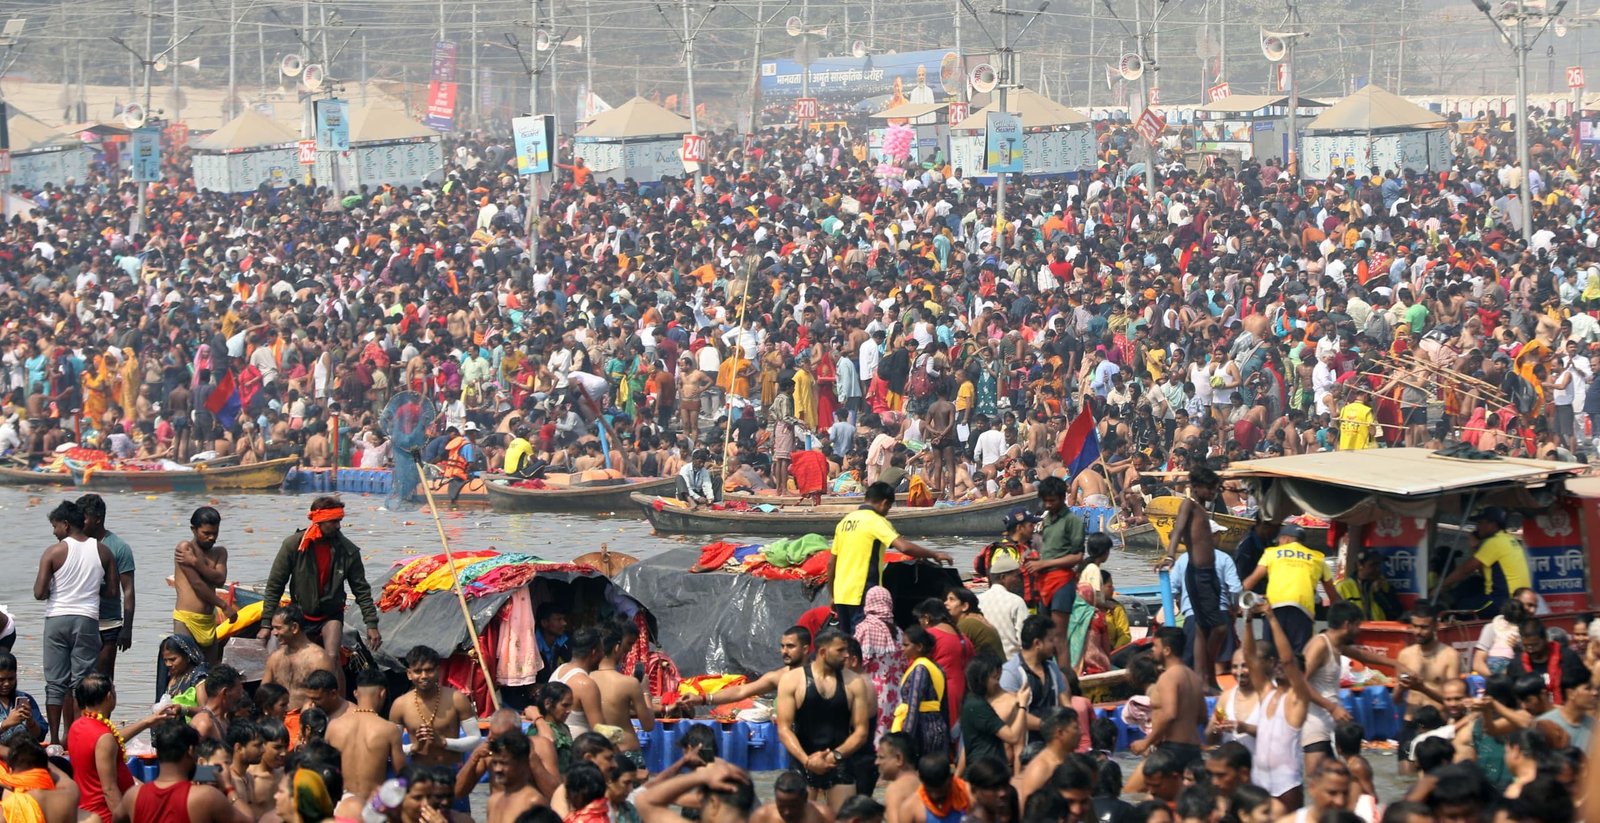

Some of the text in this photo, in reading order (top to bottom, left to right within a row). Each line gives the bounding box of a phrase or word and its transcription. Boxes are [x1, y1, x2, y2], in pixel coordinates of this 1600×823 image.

[776, 73, 802, 85] मानवता
[798, 101, 815, 117] 278
[1138, 112, 1161, 144] 237
[685, 138, 706, 160] 240
[1276, 549, 1313, 561] SDRF
